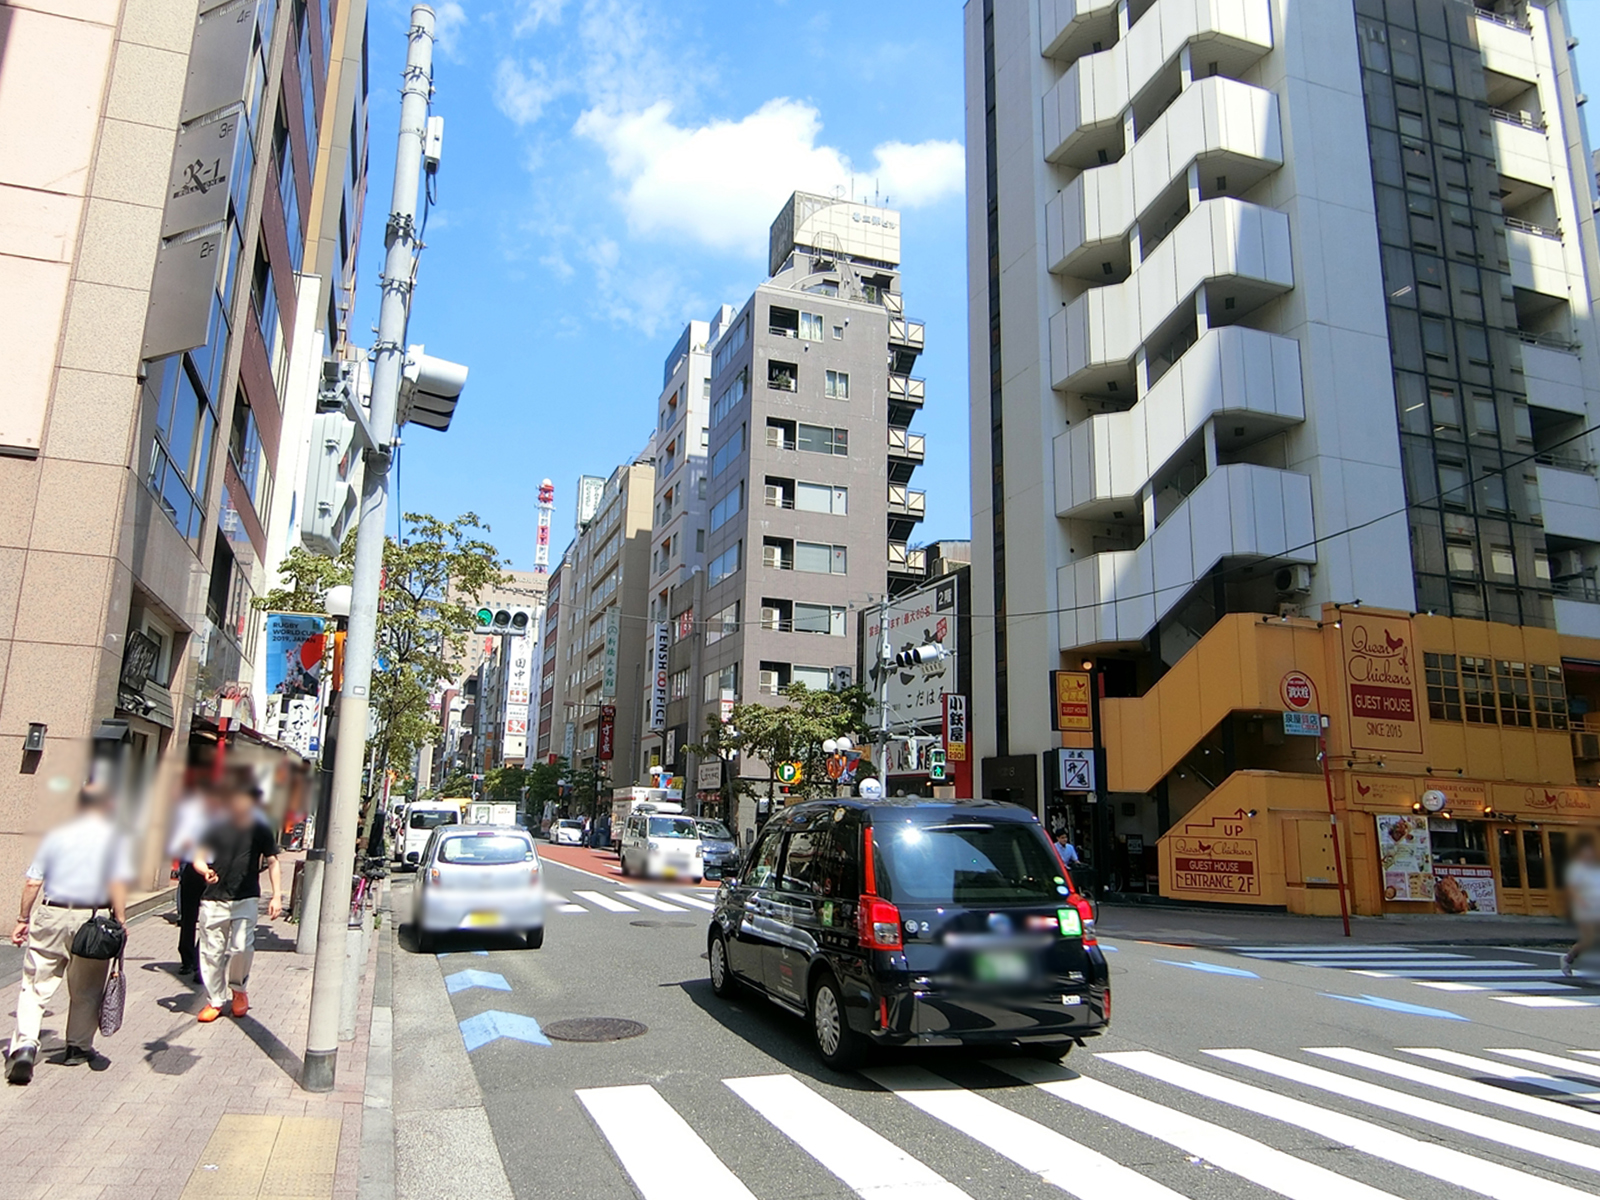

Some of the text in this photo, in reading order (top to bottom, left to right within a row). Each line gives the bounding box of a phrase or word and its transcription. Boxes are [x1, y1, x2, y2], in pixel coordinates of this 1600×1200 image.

[236, 9, 251, 25] 4F
[218, 122, 234, 139] 3F
[199, 241, 216, 259] 2F
[937, 587, 952, 606] 2階
[1351, 625, 1390, 656] Queen
[1398, 646, 1409, 673] of
[1348, 655, 1412, 686] Chickens
[1287, 686, 1310, 698] 消火栓
[1074, 706, 1087, 714] HOUSE
[1354, 694, 1412, 713] GUEST HOUSE
[1366, 721, 1403, 738] SINCE 2013
[783, 766, 794, 780] P
[1524, 788, 1547, 807] Queen
[1558, 791, 1591, 809] Chickens
[1224, 825, 1244, 836] UP
[1175, 838, 1201, 855] Queen
[1211, 841, 1253, 856] Chickens
[1188, 860, 1239, 872] GUEST HOUSE
[1184, 873, 1254, 892] ENTRANCE 2F
[920, 921, 930, 932] 2
